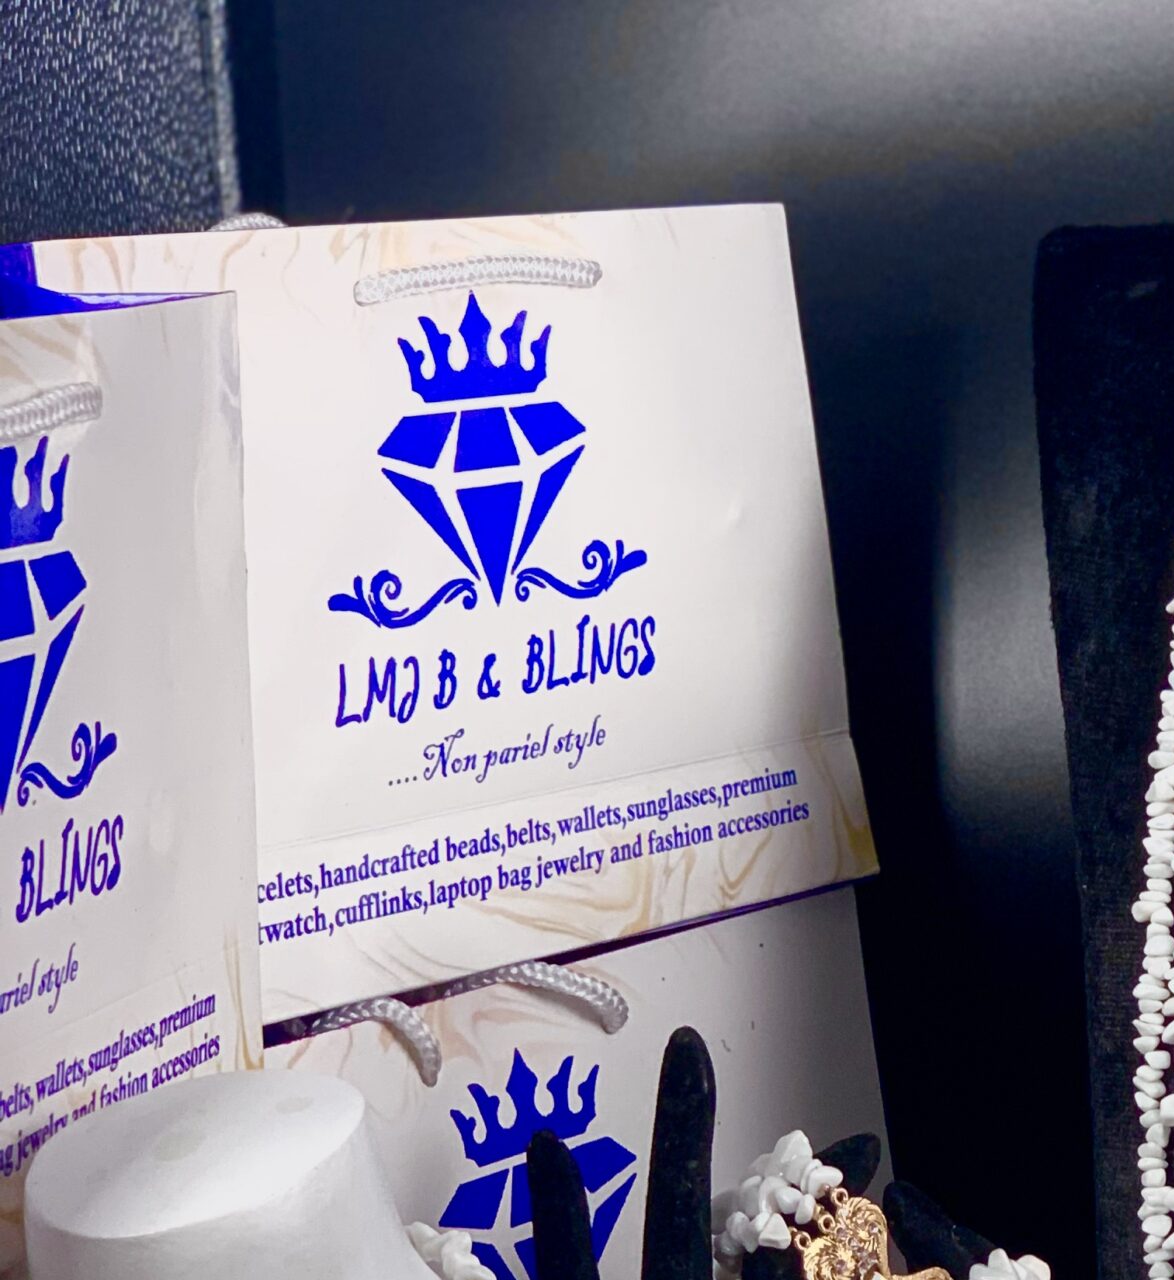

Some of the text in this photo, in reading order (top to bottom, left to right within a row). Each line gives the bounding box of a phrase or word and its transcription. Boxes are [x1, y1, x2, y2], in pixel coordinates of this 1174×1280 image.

[433, 648, 458, 710] B
[477, 652, 501, 701] &
[521, 614, 657, 694] BLINGS
[475, 722, 554, 784] pariel
[553, 714, 607, 770] style
[15, 814, 124, 924] BLINGS
[497, 863, 532, 892] bag
[534, 846, 606, 888] jewelry
[609, 833, 644, 865] and
[647, 822, 714, 857] fashion
[717, 799, 811, 840] accessories
[38, 941, 79, 1015] style
[150, 1033, 221, 1089] accessories
